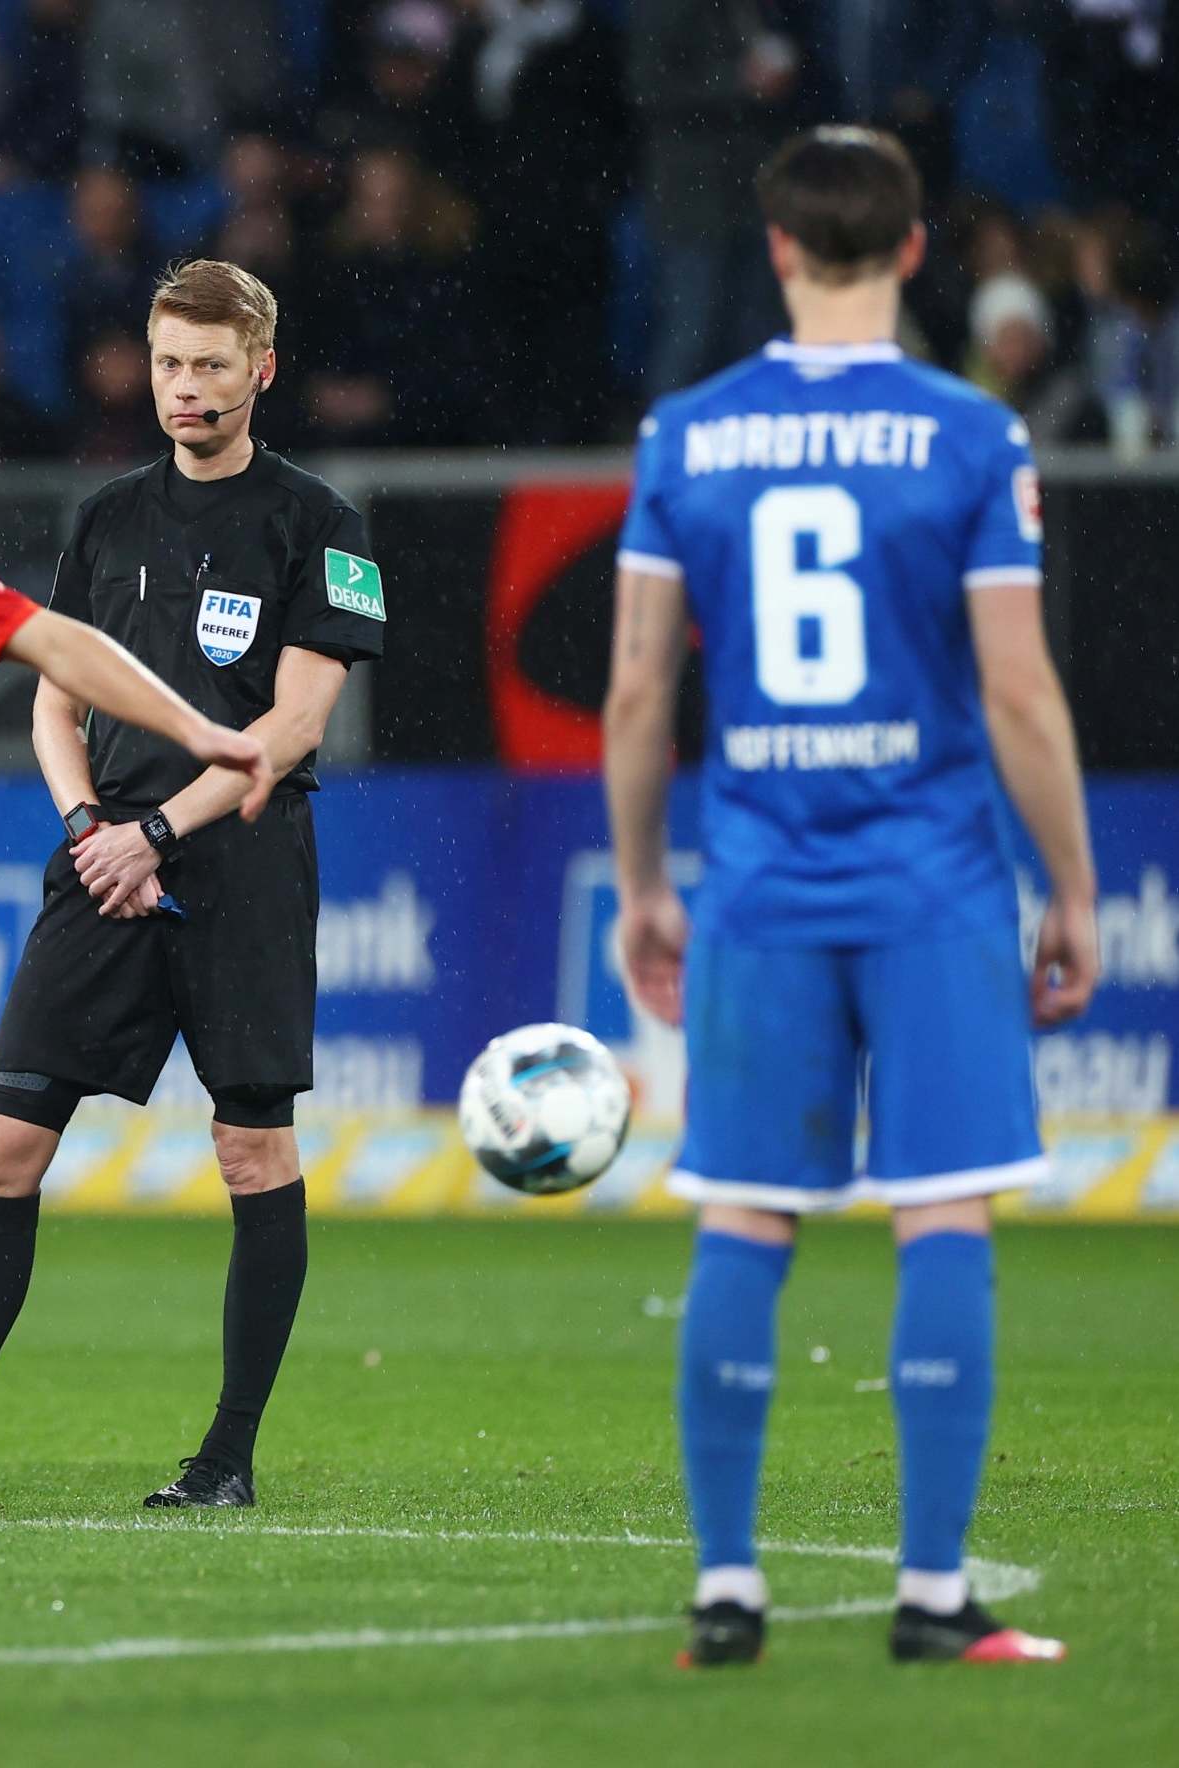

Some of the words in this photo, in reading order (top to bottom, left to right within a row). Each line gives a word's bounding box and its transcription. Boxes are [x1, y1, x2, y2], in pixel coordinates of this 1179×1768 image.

[685, 411, 939, 476] NORDTVEIT
[205, 595, 253, 619] FIFA
[330, 585, 383, 617] DEKRA
[751, 484, 867, 705] 6
[201, 622, 251, 640] REFEREE
[210, 648, 233, 660] 2020
